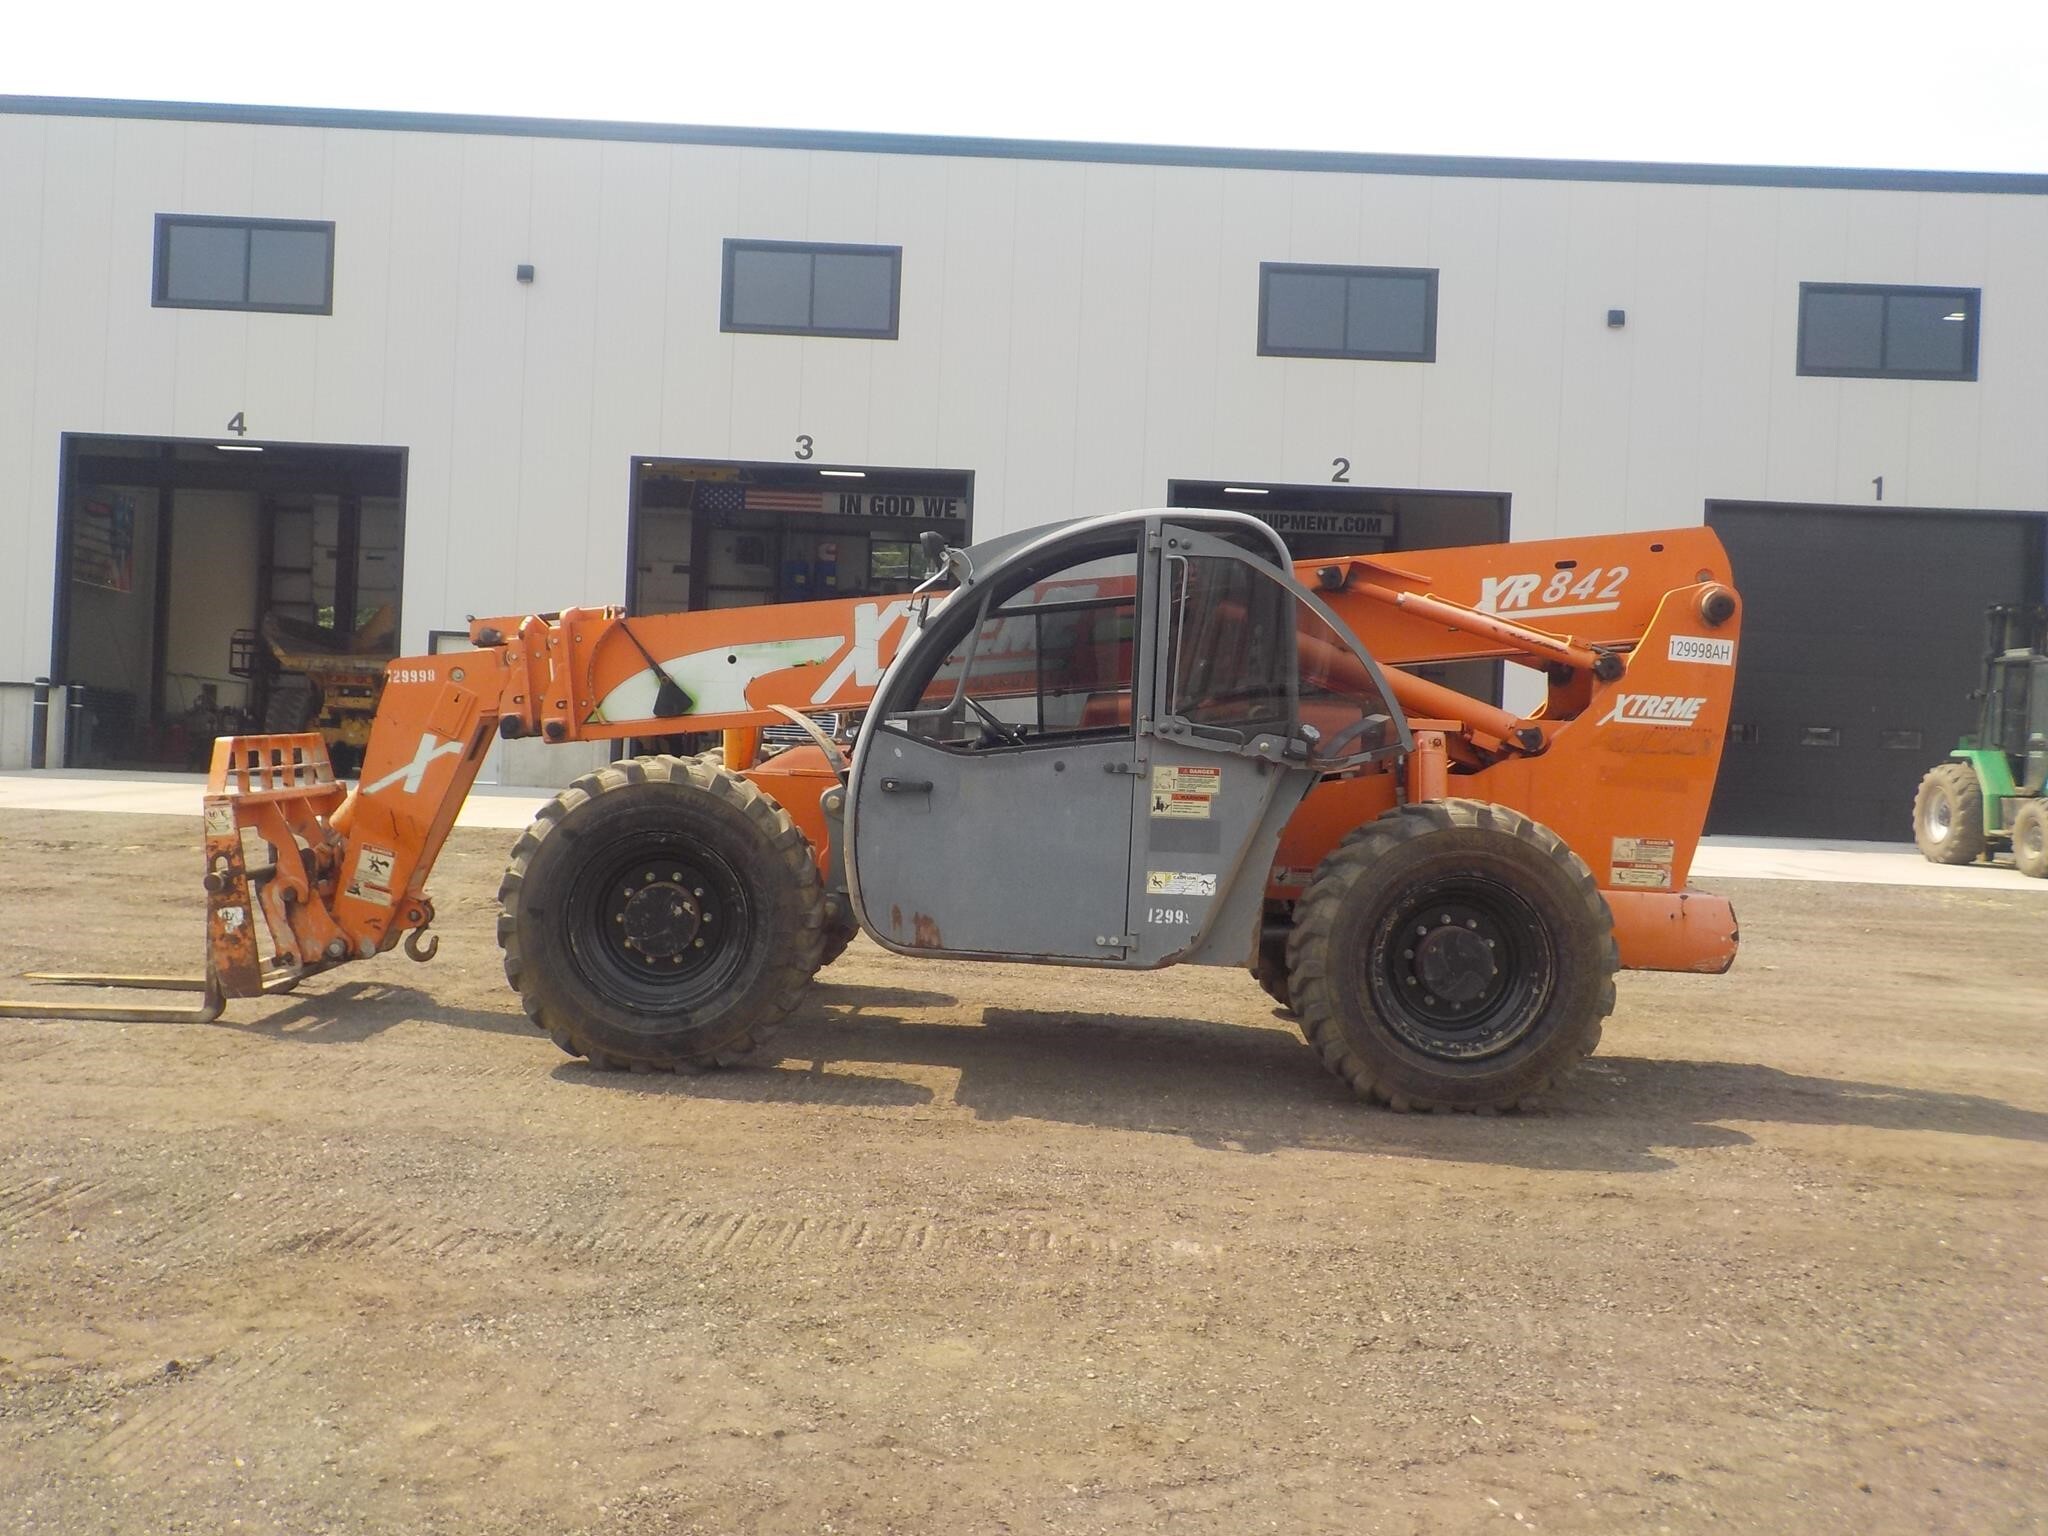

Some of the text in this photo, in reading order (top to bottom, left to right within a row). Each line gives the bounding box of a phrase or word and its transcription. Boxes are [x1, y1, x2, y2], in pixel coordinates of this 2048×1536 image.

[227, 411, 247, 437] 4
[794, 434, 814, 460] 3
[1331, 457, 1351, 483] 2
[1871, 476, 1883, 501] 1
[839, 494, 959, 519] IN GOD WE
[1541, 565, 1631, 604] 842
[1670, 639, 1730, 661] 129998AH
[1595, 693, 1708, 727] XTREME
[1147, 907, 1190, 925] 1299
